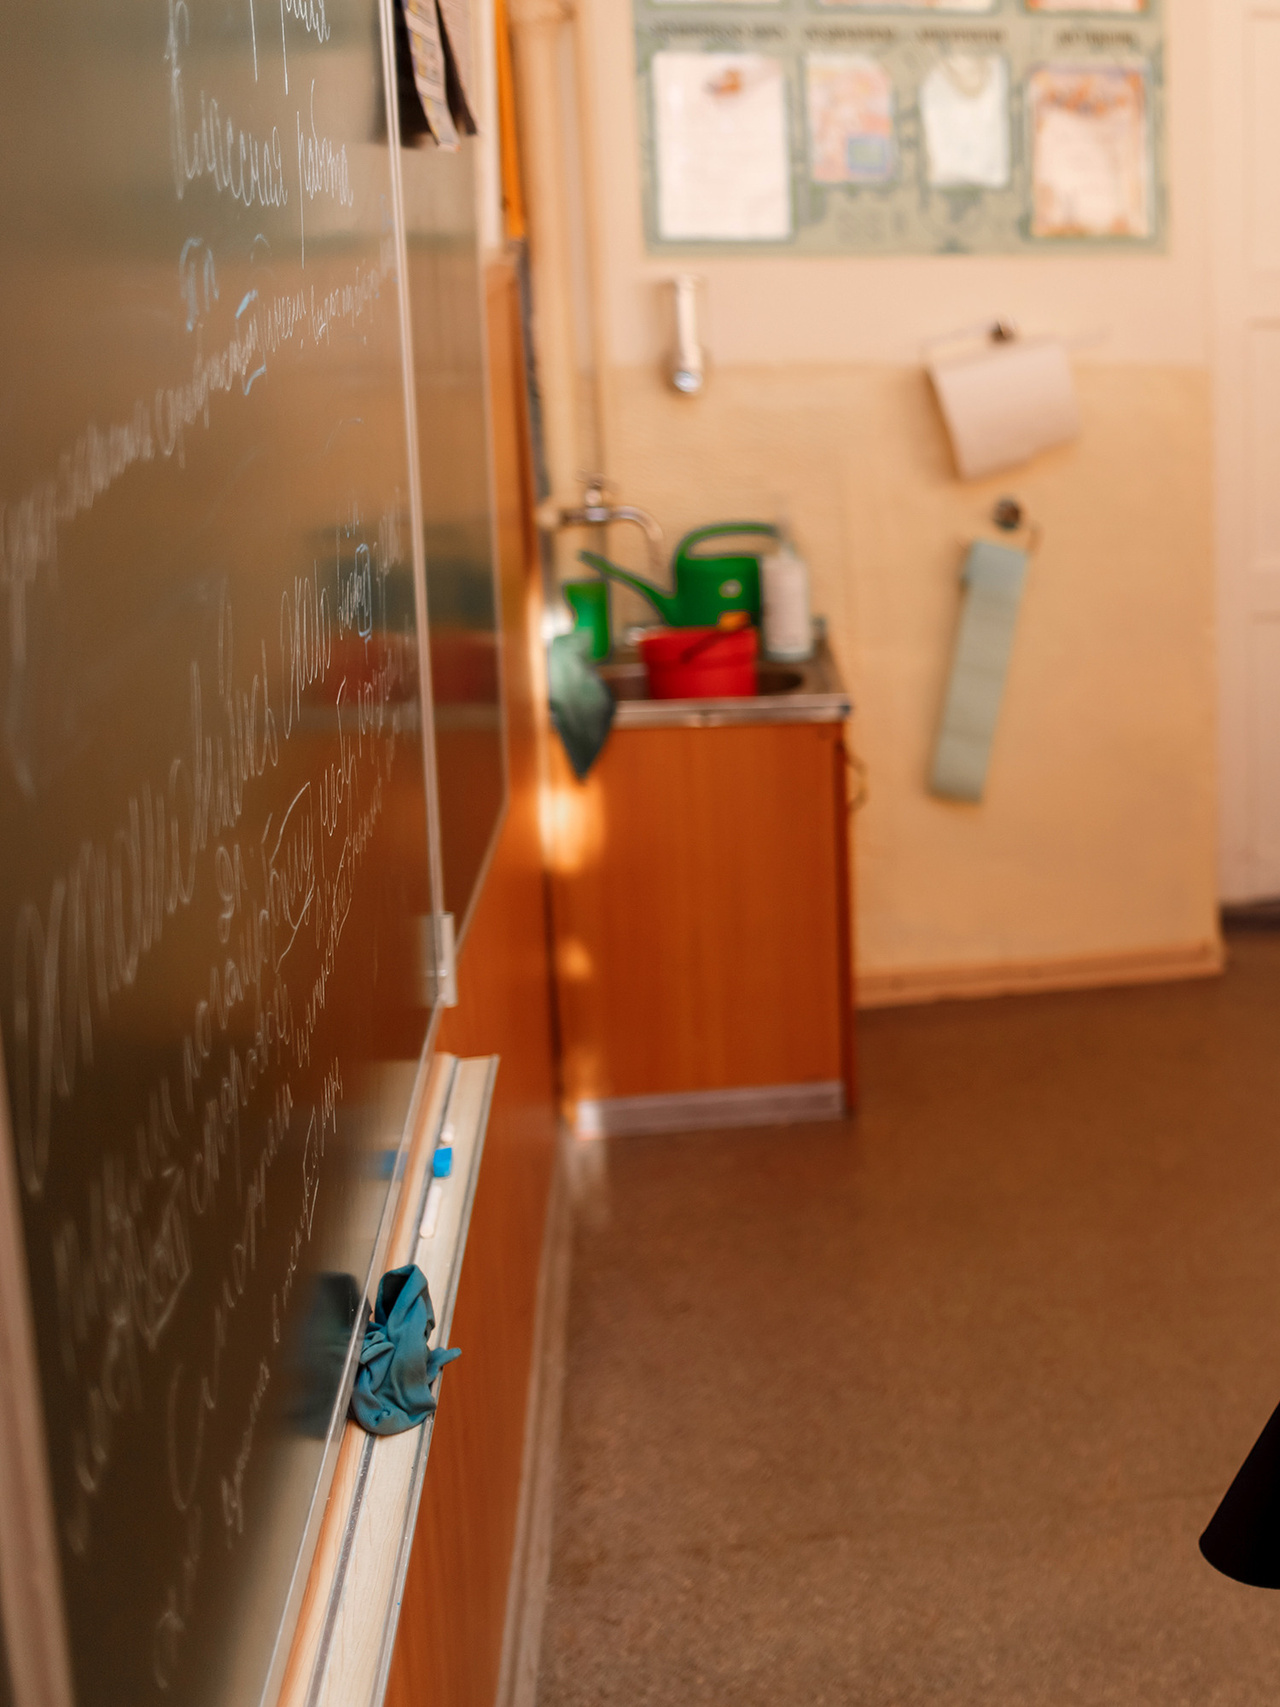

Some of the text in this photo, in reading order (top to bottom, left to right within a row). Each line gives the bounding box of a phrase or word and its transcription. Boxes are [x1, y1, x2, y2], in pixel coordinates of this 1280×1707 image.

[164, 0, 288, 206] Классная
[296, 78, 354, 270] работа
[275, 558, 332, 738] около
